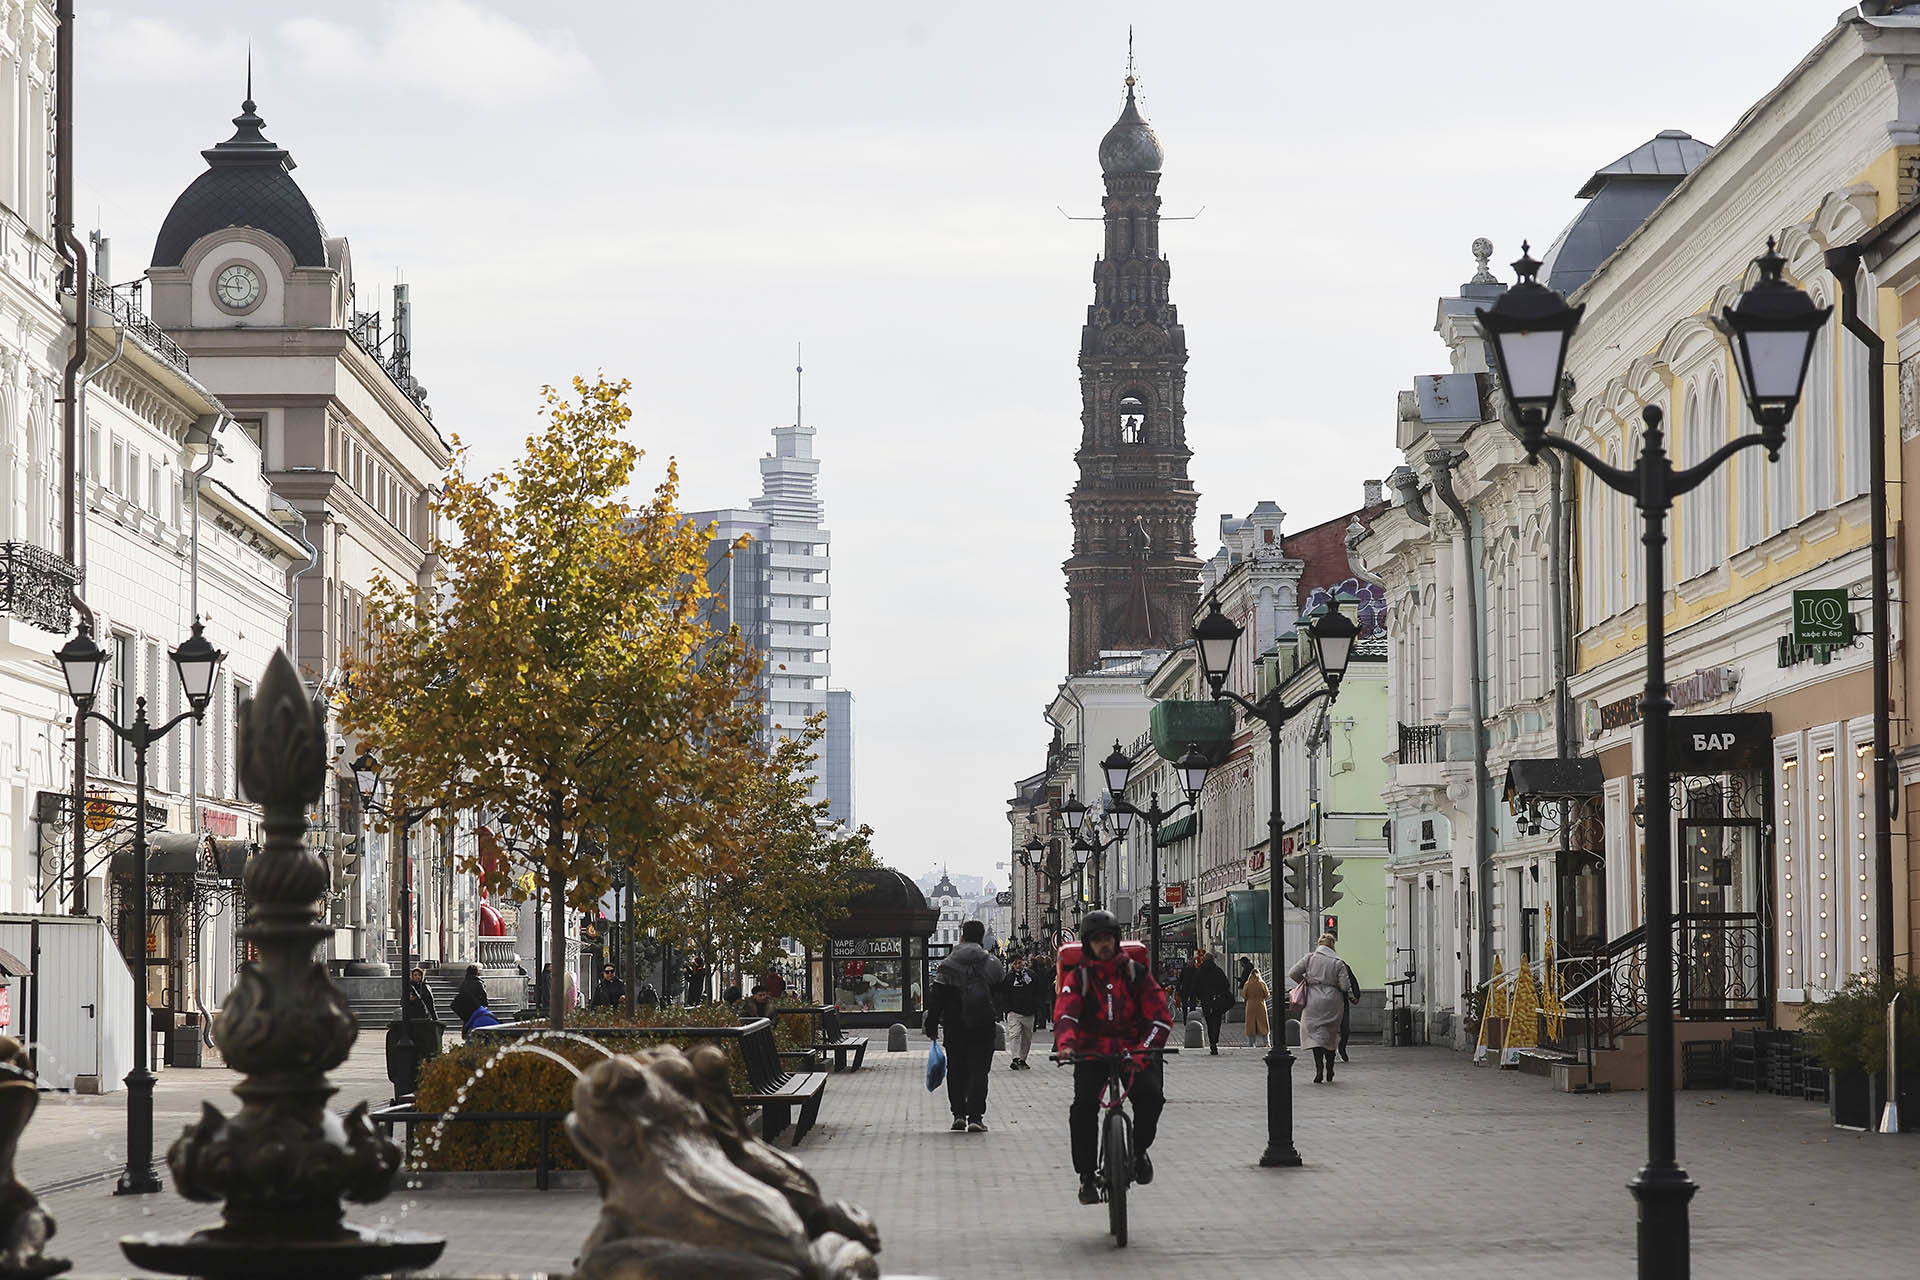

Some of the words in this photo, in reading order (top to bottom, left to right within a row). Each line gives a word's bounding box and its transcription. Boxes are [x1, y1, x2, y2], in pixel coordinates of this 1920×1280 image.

[1799, 597, 1843, 630] IQ
[1801, 630, 1821, 638] кафе
[1828, 630, 1843, 638] бар
[1692, 733, 1736, 751] БАР
[834, 939, 854, 948] VAPE
[869, 942, 900, 953] ТАБАК
[834, 948, 855, 956] SHOP
